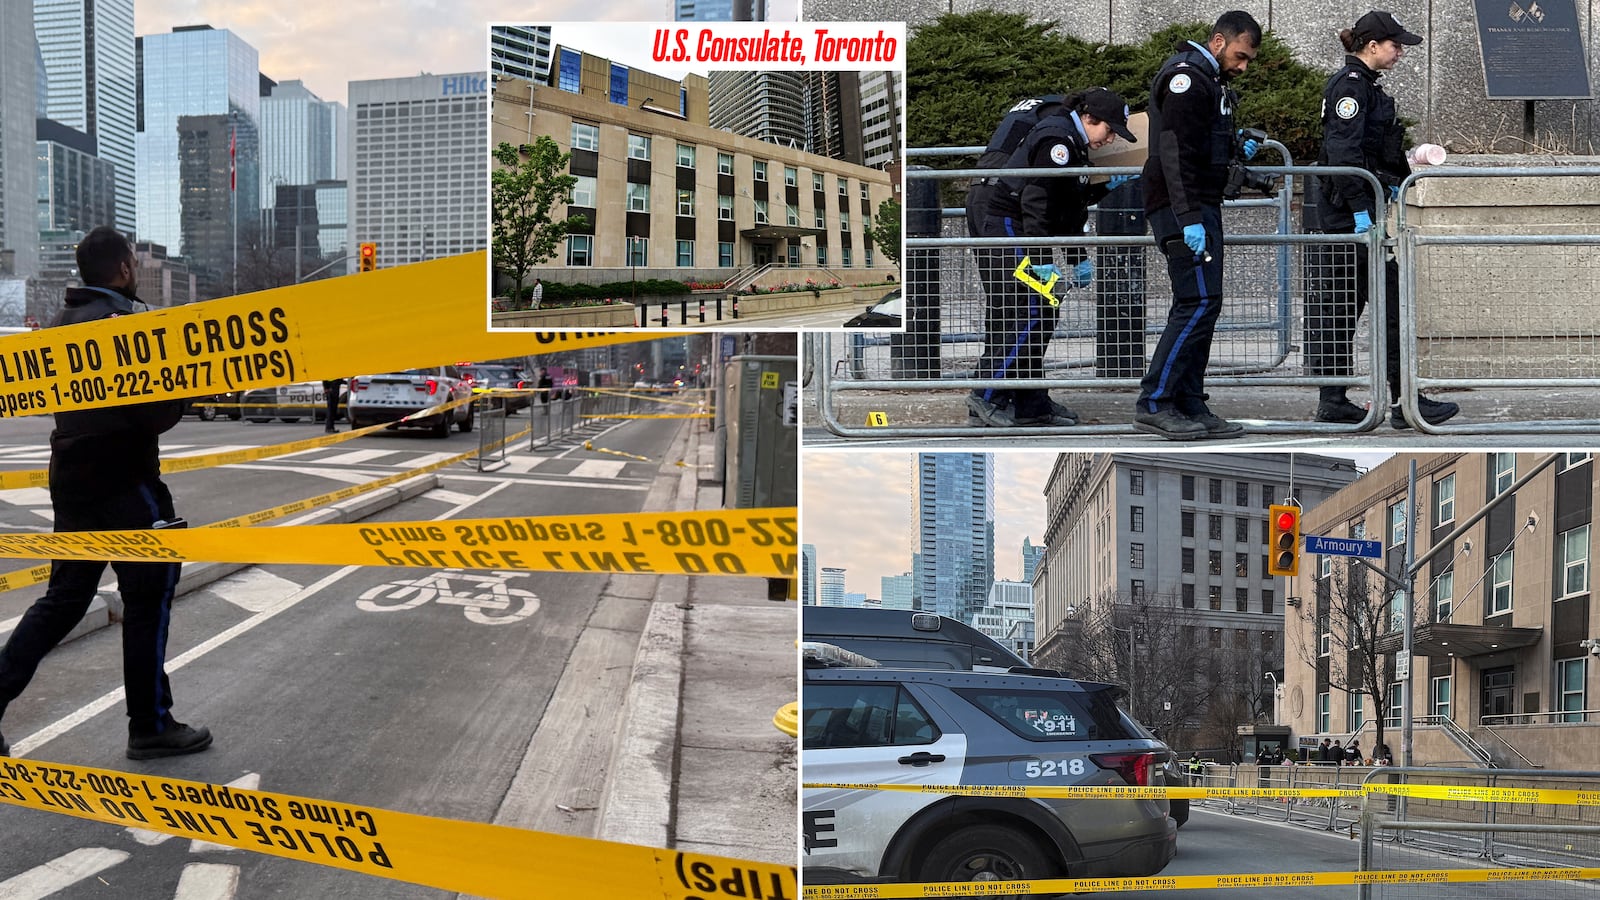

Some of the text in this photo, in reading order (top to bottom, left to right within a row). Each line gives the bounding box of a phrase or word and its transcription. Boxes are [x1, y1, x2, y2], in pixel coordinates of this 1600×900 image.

[0, 306, 289, 384] LINE DO NOT CROSS
[50, 361, 214, 406] 1-800-222-8477
[222, 348, 295, 389] (TIPS)
[875, 413, 883, 425] 6
[1315, 537, 1363, 556] Armoury
[1025, 758, 1085, 778] 5218
[32, 787, 95, 814] NOT
[99, 797, 149, 823] DO
[160, 782, 283, 822] Stoppers
[153, 806, 239, 840] LINE
[288, 800, 377, 837] Crime
[245, 821, 394, 869] POLICE
